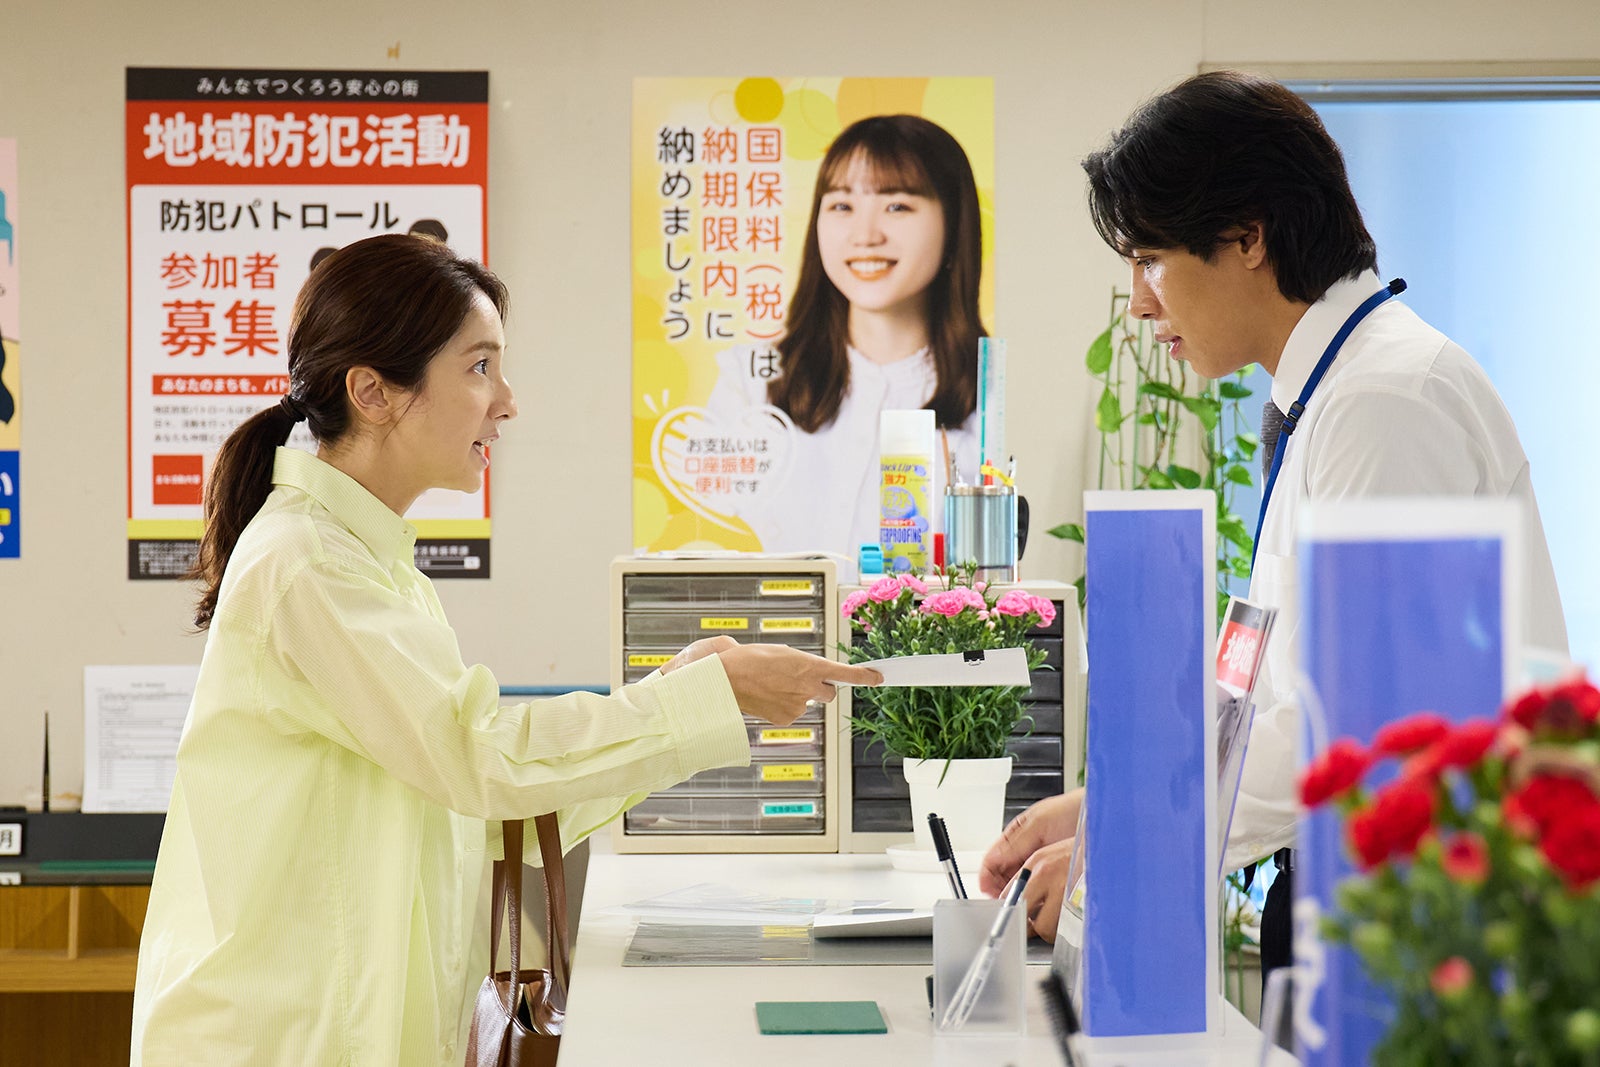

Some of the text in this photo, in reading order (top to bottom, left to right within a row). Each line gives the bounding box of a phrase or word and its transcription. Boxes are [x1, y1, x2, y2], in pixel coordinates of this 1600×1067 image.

[196, 77, 420, 97] みんなでつくろう安心の街
[143, 111, 470, 168] 地域防犯活動
[160, 200, 399, 232] 防犯パトロール
[658, 127, 694, 340] 納めましょう
[702, 127, 738, 339] 納期限内に
[160, 252, 280, 290] 参加者
[161, 300, 279, 357] 募集
[688, 438, 767, 453] お支払いは
[685, 456, 771, 474] 口座振替が
[696, 476, 759, 493] 便利です
